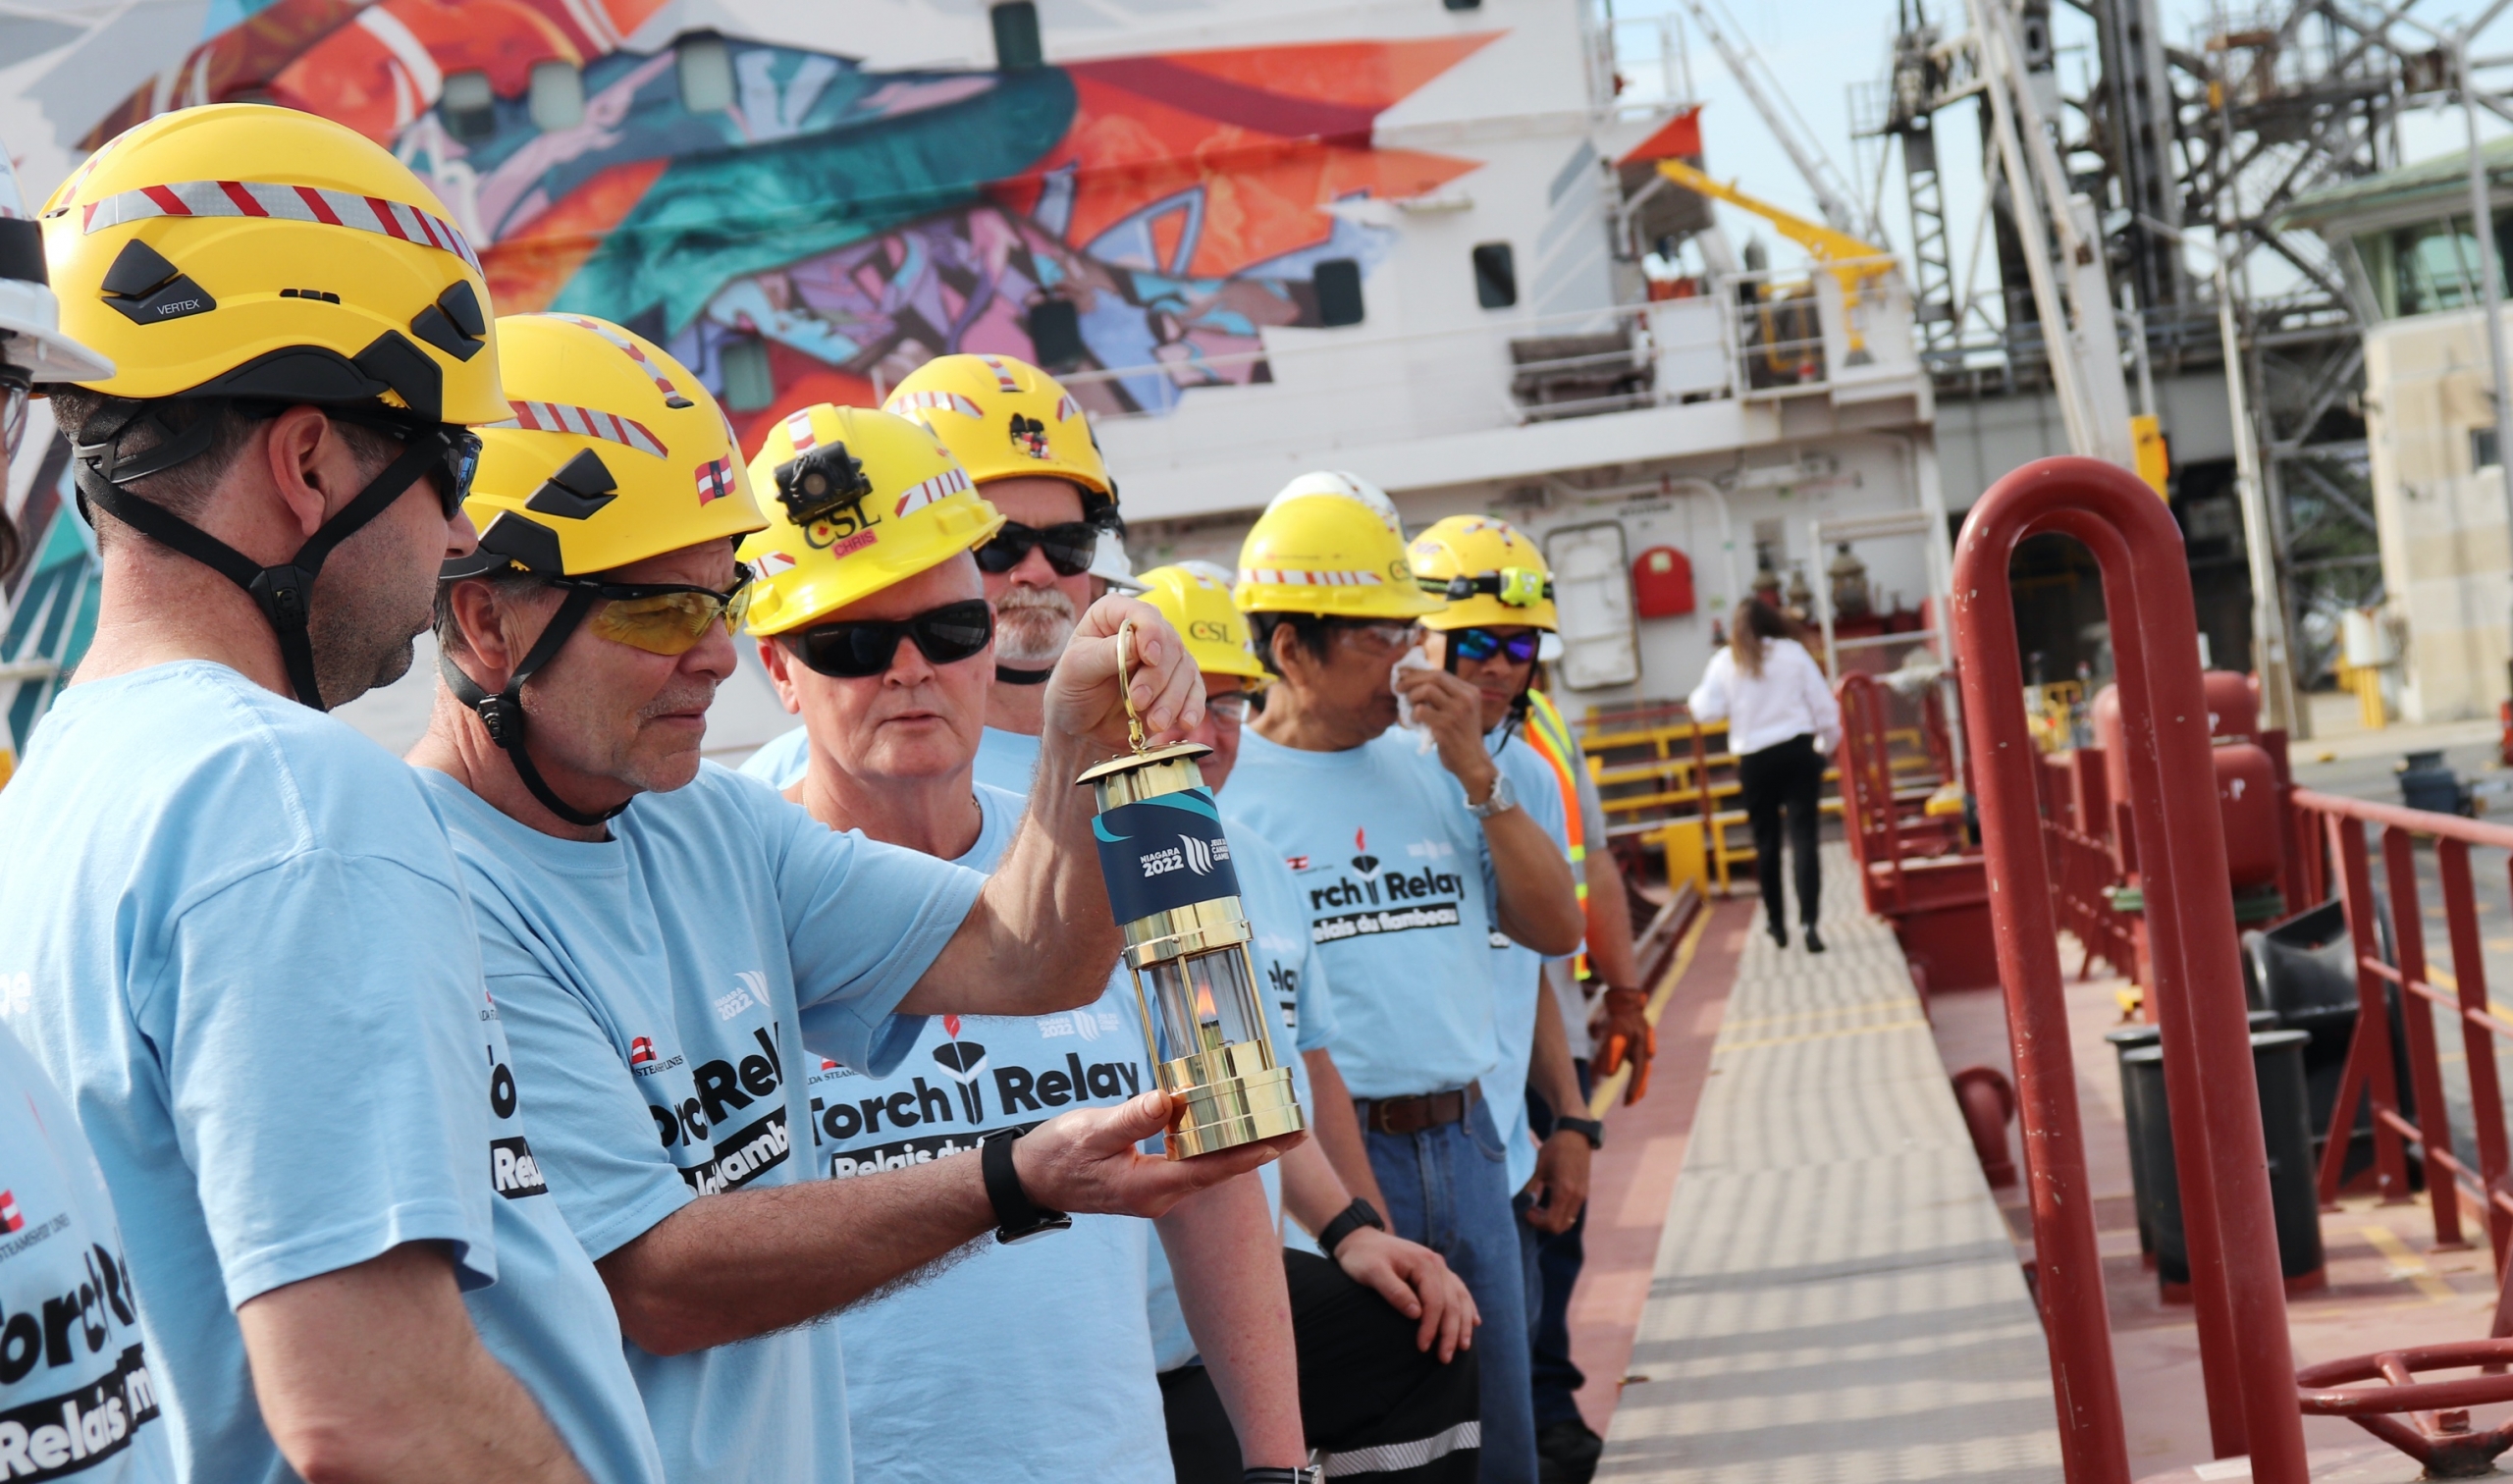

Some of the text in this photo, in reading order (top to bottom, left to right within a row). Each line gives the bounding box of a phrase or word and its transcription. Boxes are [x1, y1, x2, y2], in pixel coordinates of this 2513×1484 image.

[157, 298, 200, 315] VERTEX
[804, 502, 882, 550] CSL
[833, 531, 876, 557] CHRIS
[1190, 620, 1235, 645] CSL
[1140, 847, 1180, 863] NIAGARA
[1143, 856, 1184, 877] 2022
[1384, 866, 1465, 901] Relay
[718, 993, 754, 1021] 2022
[1041, 1024, 1075, 1039] 2022
[664, 1054, 684, 1071] LINES
[992, 1052, 1140, 1116] Relay
